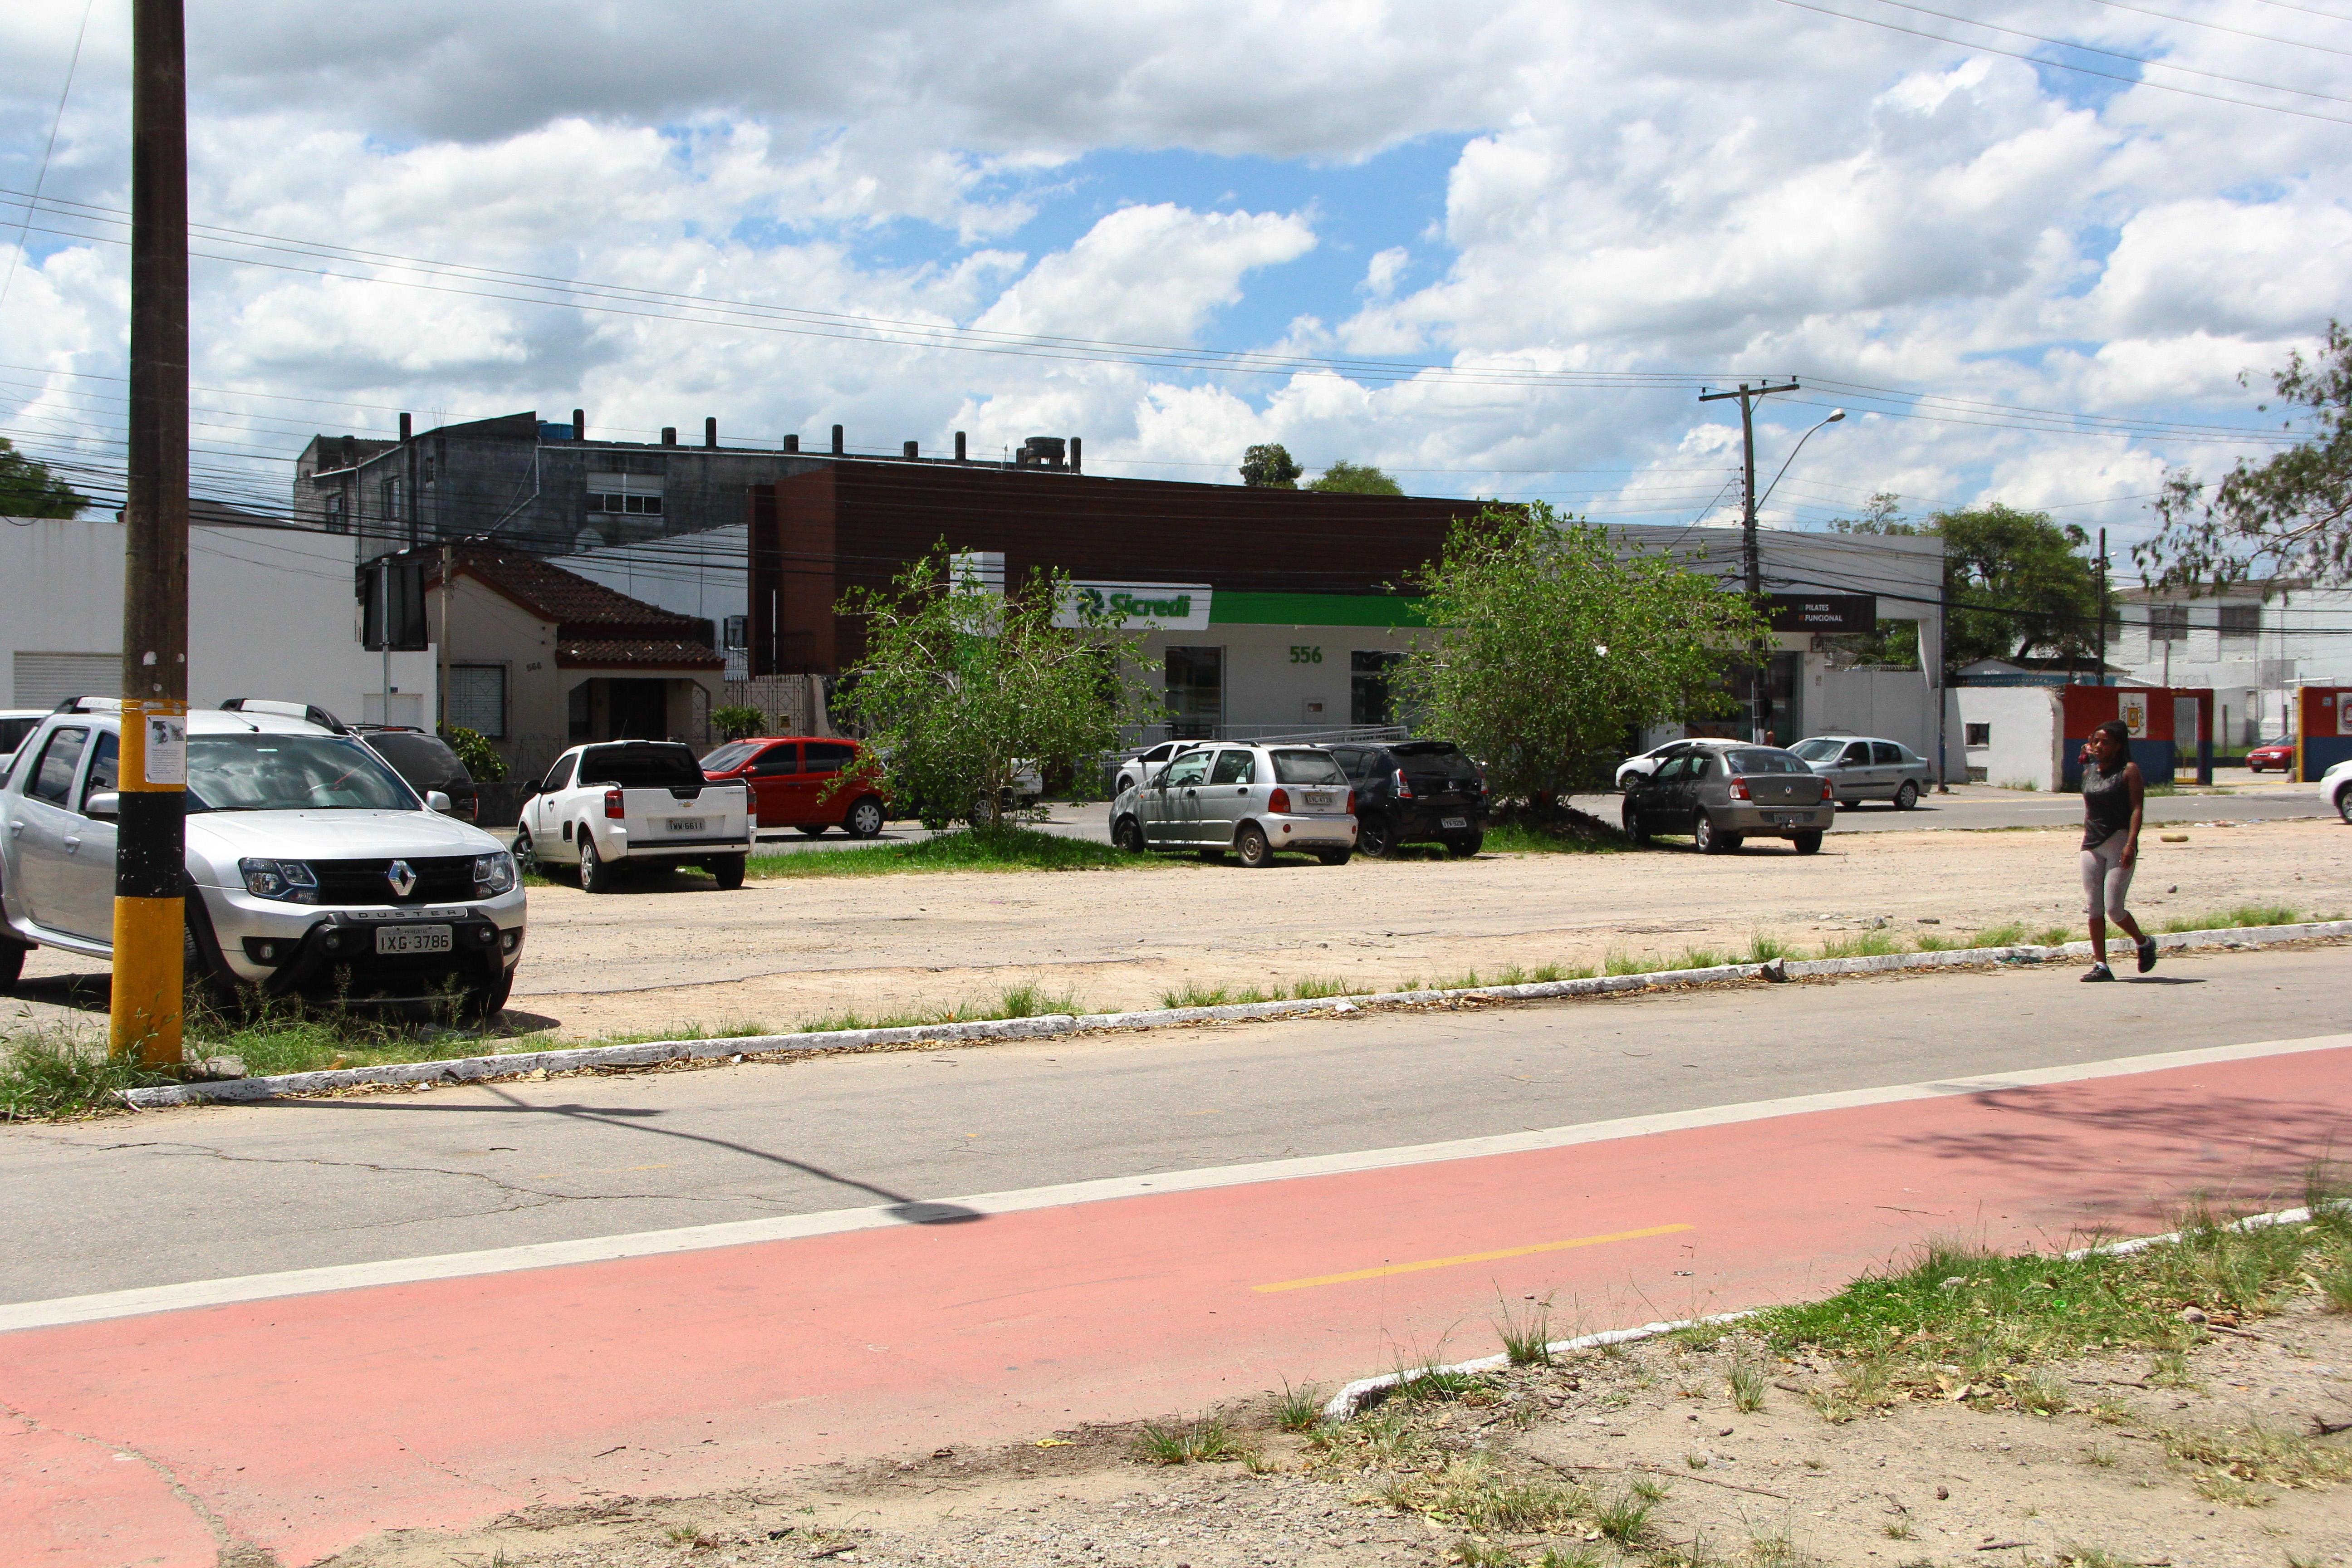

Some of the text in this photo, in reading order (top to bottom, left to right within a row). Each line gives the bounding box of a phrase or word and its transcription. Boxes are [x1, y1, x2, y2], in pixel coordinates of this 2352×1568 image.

[1109, 593, 1191, 617] Sicredi
[1290, 646, 1323, 663] 556
[358, 910, 457, 918] DUSTER
